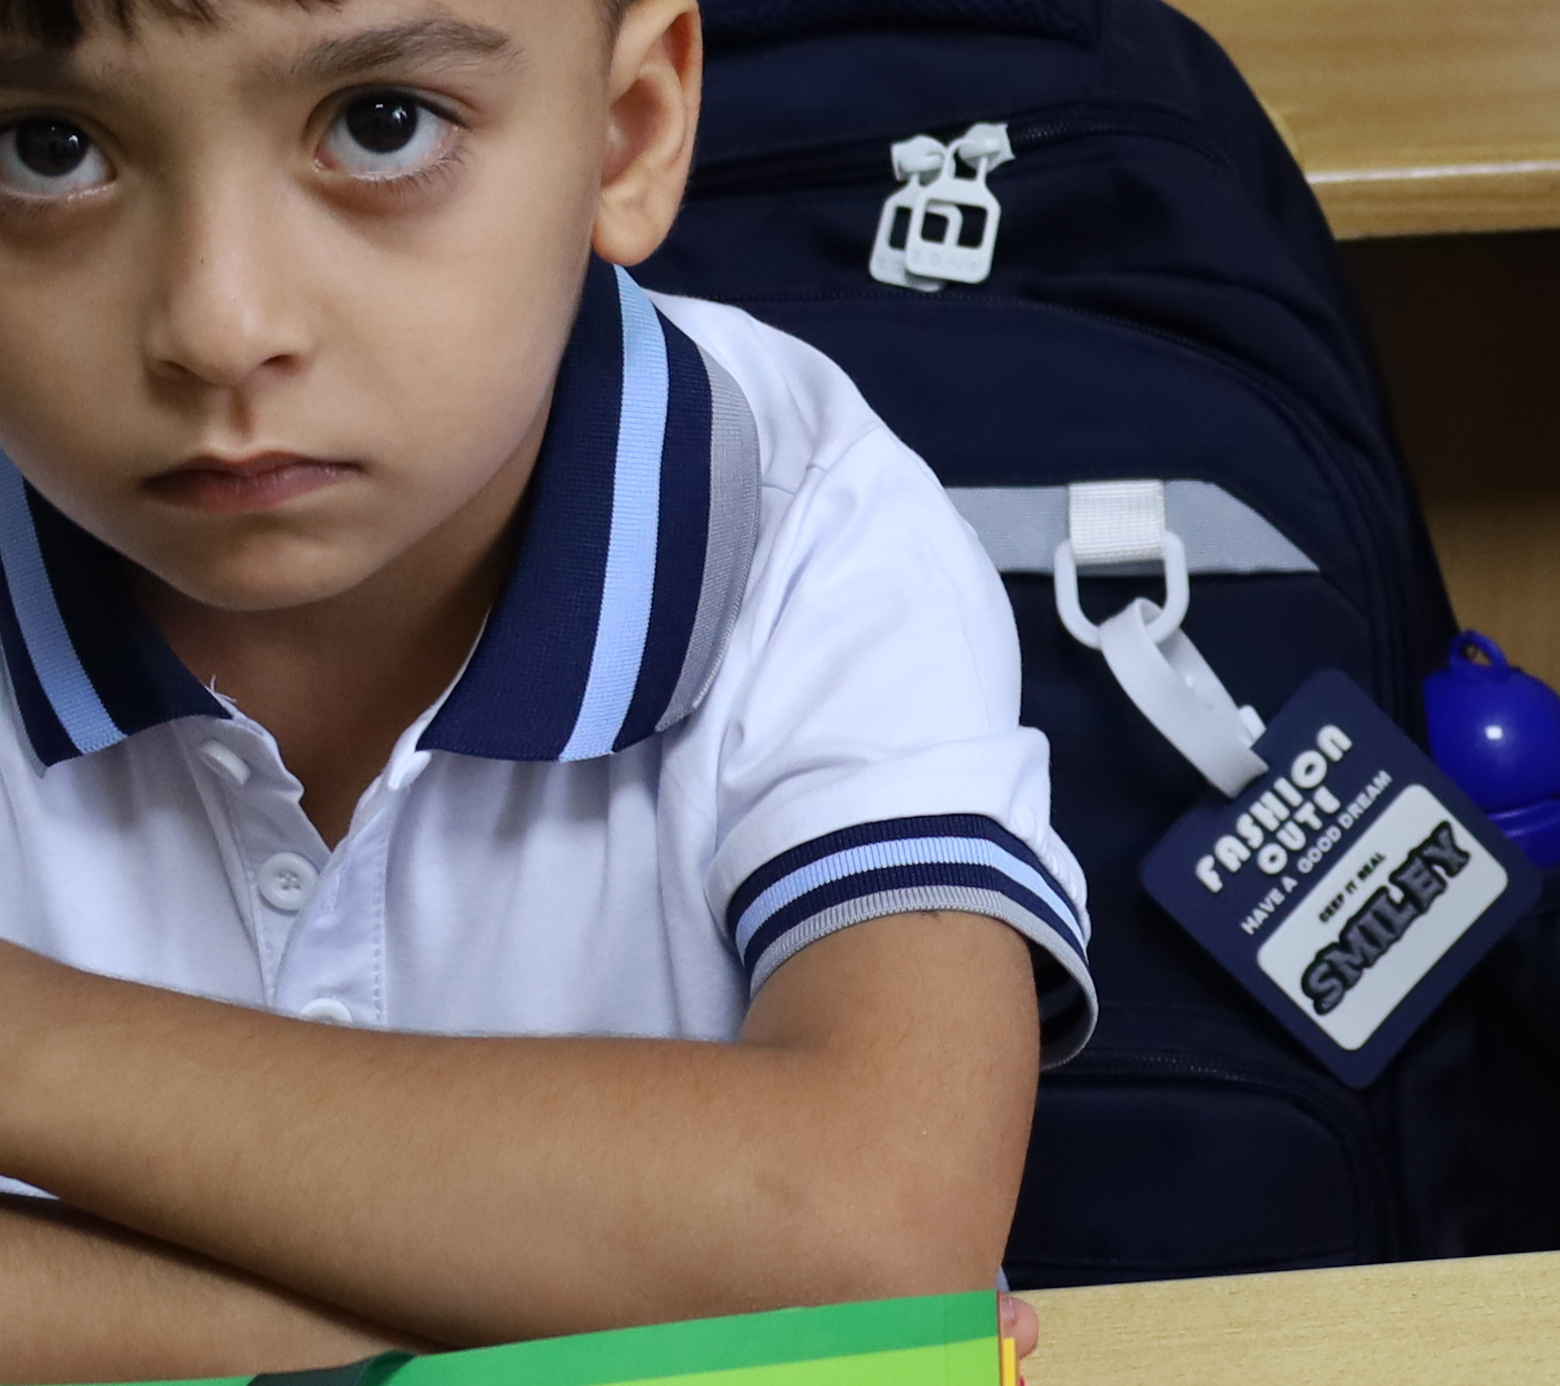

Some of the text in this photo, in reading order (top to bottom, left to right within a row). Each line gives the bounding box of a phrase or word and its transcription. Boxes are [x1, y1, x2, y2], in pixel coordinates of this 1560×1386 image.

[1195, 723, 1354, 894] FASHION
[1240, 769, 1393, 935] HAVE A GOOD DREAM
[1344, 877, 1359, 896] IT
[1357, 851, 1387, 881] REAL
[1300, 820, 1471, 1017] SMILEY
